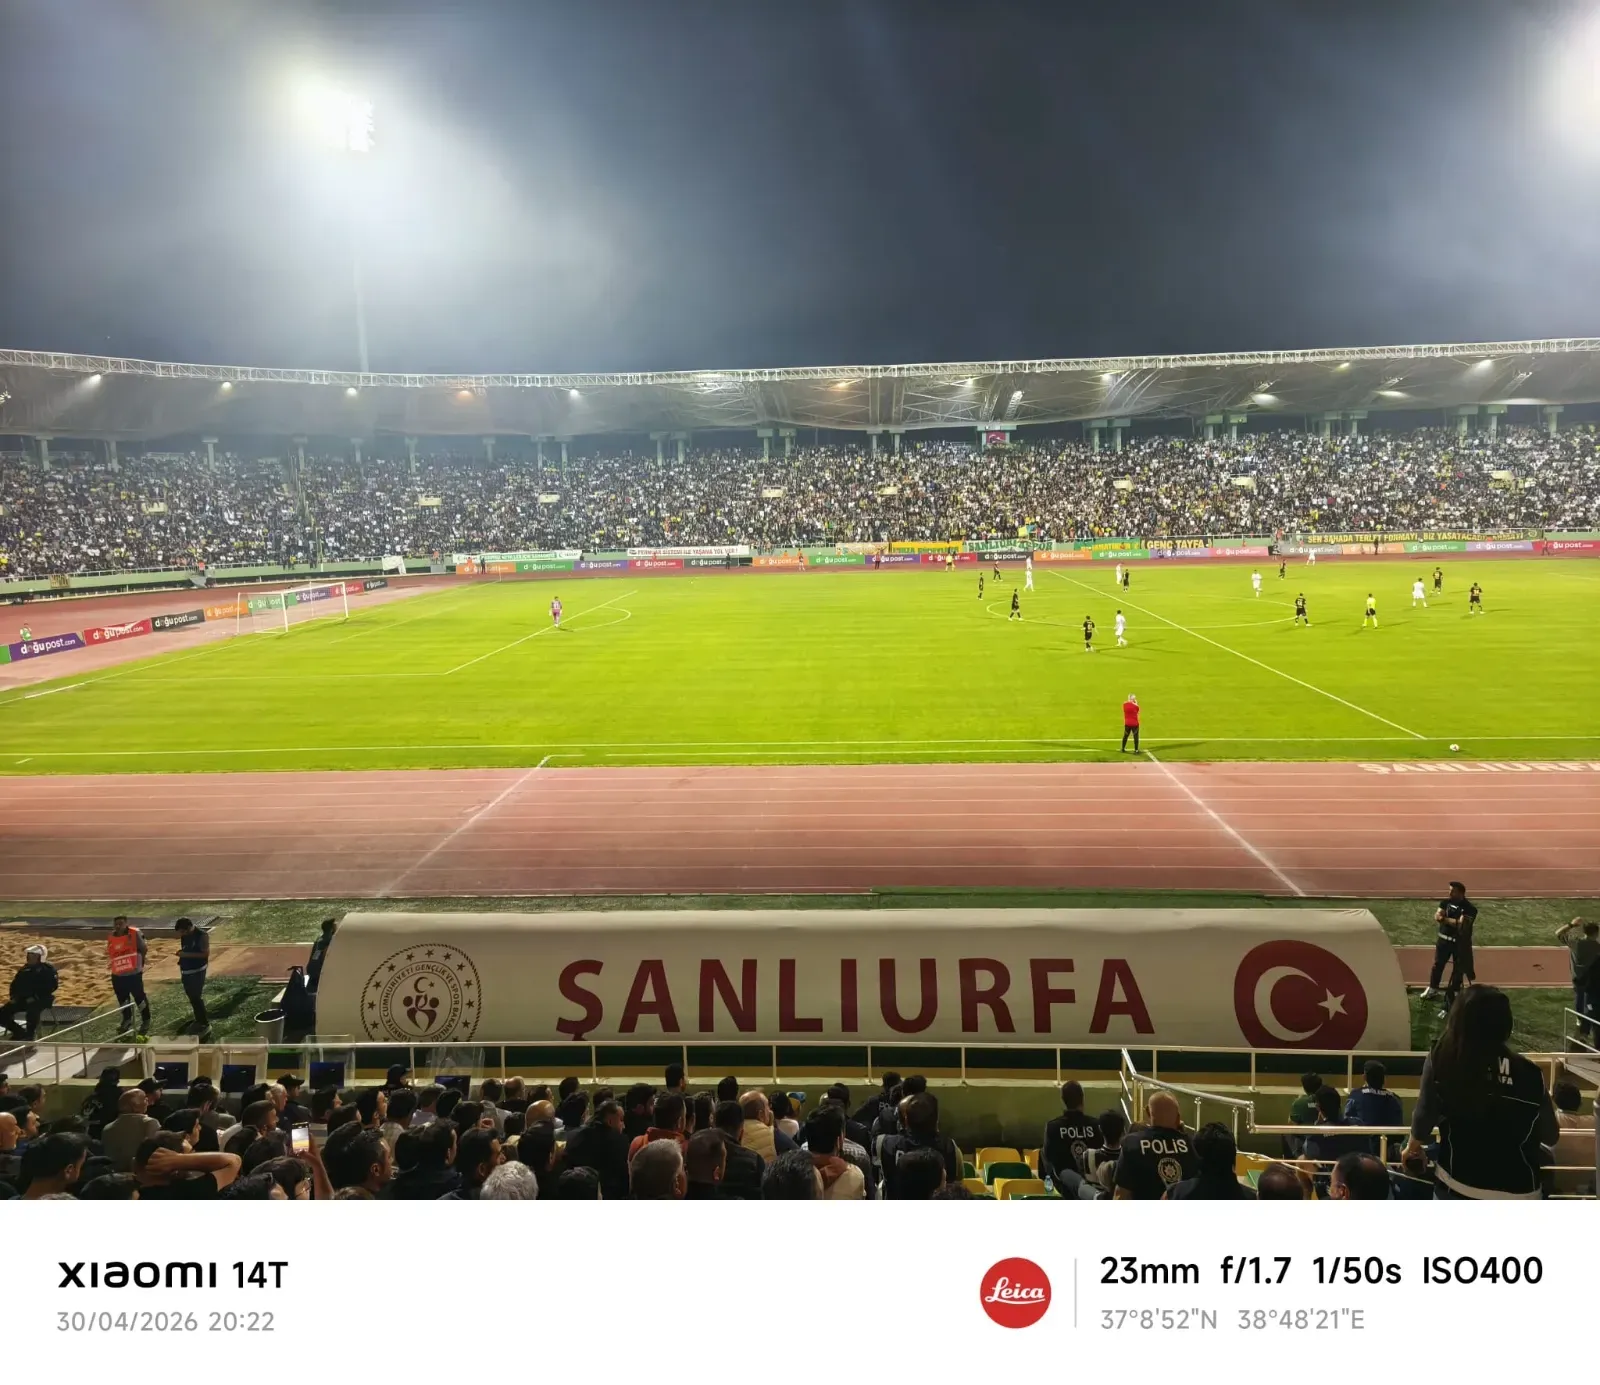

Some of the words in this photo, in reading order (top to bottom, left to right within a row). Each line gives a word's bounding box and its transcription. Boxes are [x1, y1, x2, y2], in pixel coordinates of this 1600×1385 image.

[1175, 539, 1205, 548] TAYFA
[414, 963, 447, 977] GENÇLİK
[445, 973, 456, 984] VE
[381, 968, 414, 1018] CUMHURİYETİ
[450, 982, 460, 1006] SPOR
[556, 958, 1156, 1041] ŞANLIURFA
